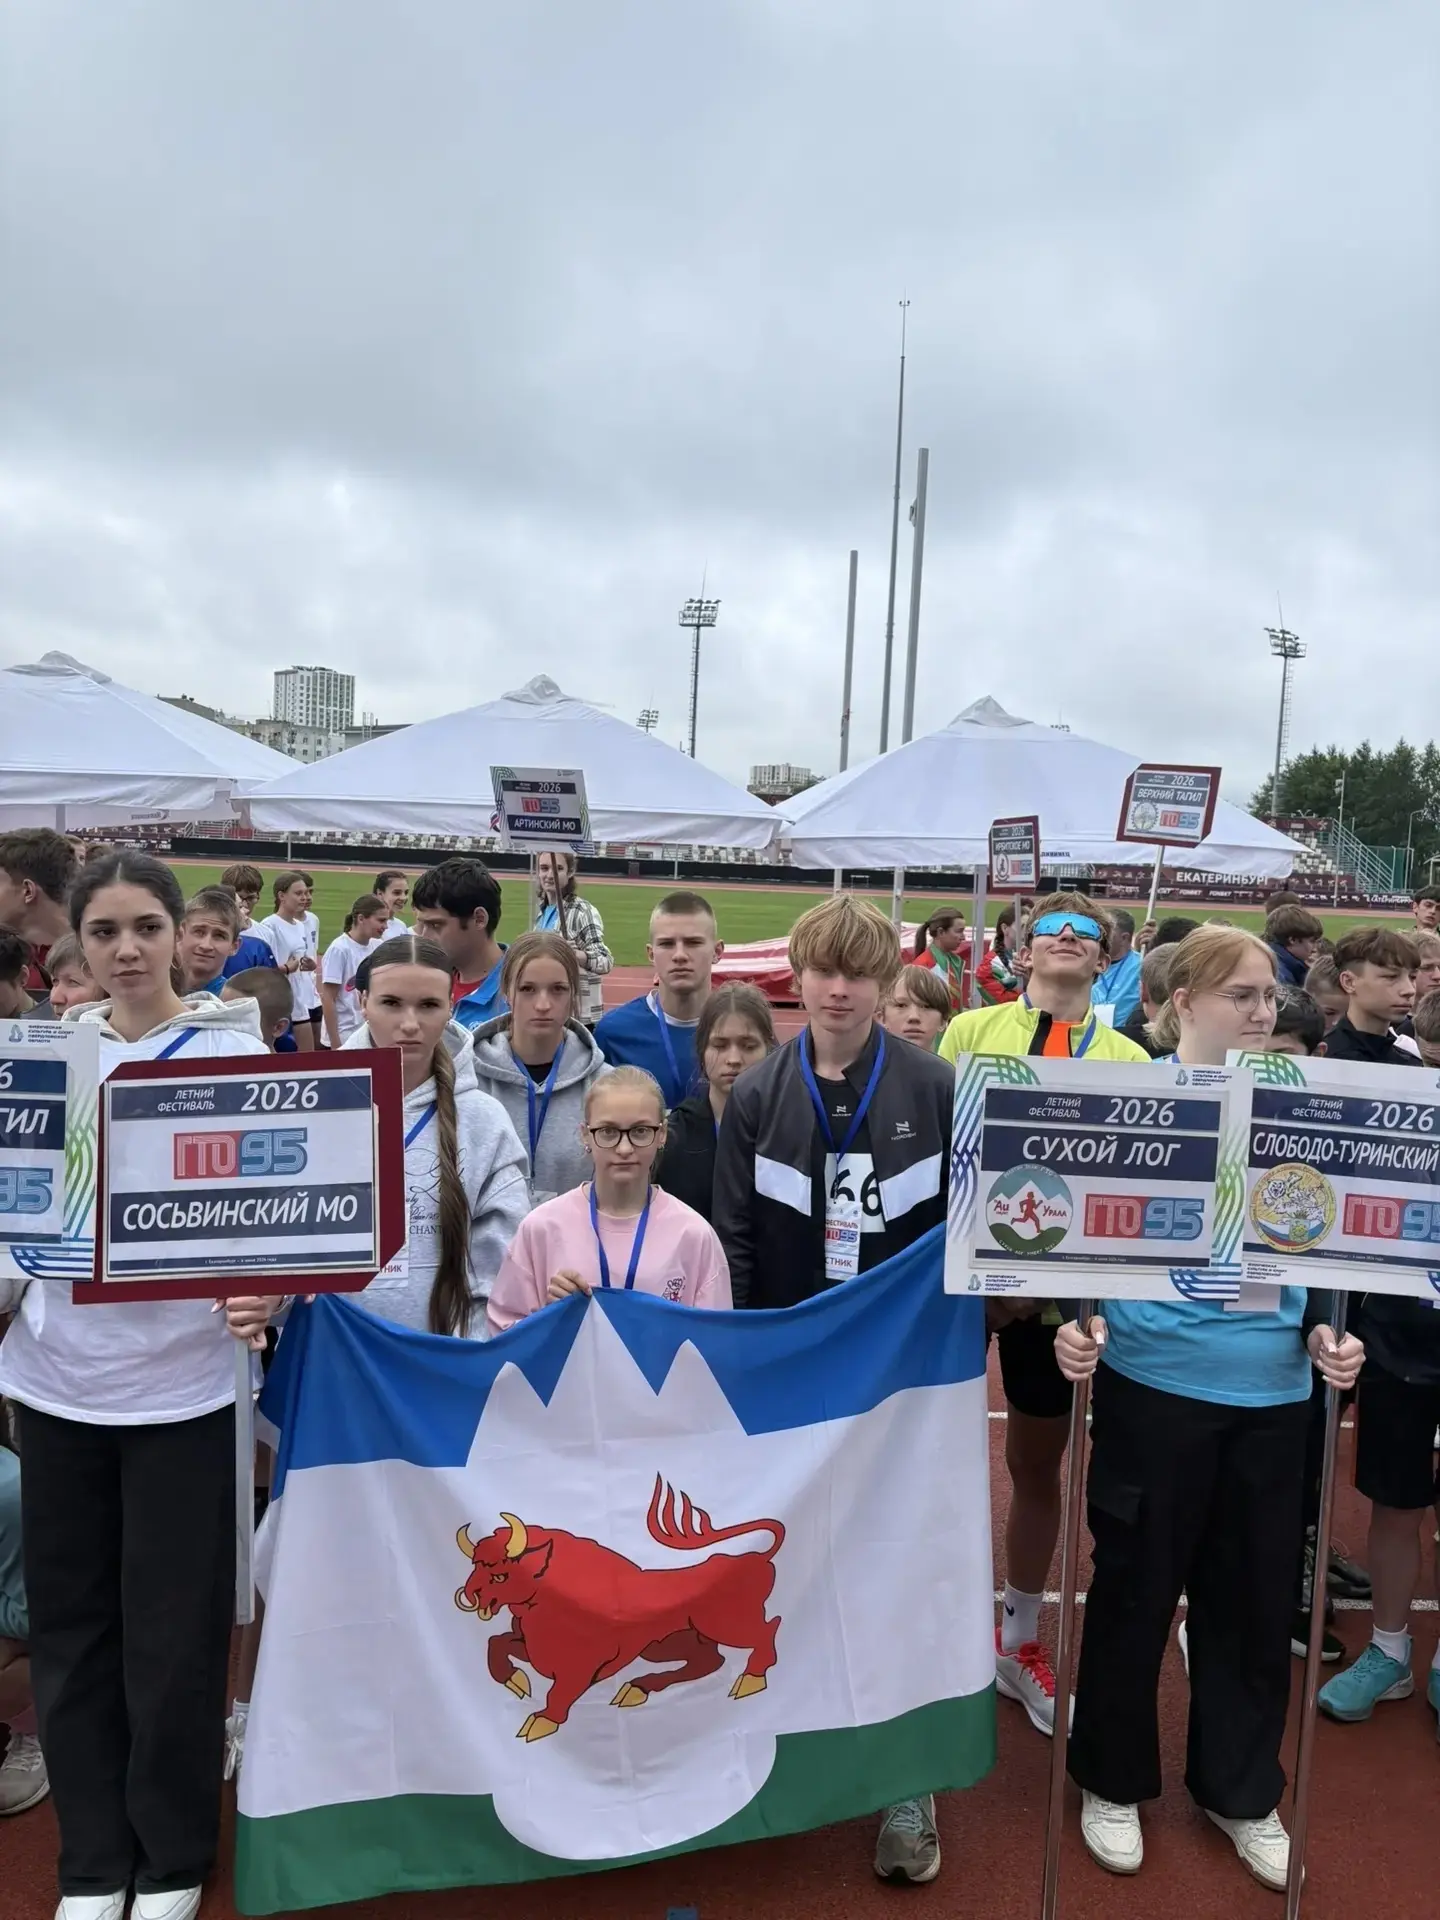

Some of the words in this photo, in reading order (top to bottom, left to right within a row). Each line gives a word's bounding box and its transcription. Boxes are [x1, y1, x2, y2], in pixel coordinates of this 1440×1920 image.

[1171, 775, 1195, 786] 2026
[538, 783, 561, 792] 2026
[1138, 788, 1174, 800] ВЕРХНИЙ
[1176, 791, 1202, 802] ТАГИЛ
[514, 819, 560, 830] АРТИНСКИЙ
[562, 822, 576, 830] МО
[175, 1087, 215, 1100] ЛЕТНИЙ
[241, 1080, 319, 1112] 2026
[157, 1101, 215, 1112] ФЕСТИВАЛЬ
[1045, 1096, 1082, 1108] ЛЕТНИЙ
[1308, 1098, 1343, 1110] ЛЕТНИЙ
[1028, 1107, 1081, 1119] ФЕСТИВАЛЬ
[1104, 1097, 1176, 1126] 2026
[1292, 1108, 1342, 1120] ФЕСТИВАЛЬ
[1365, 1102, 1435, 1132] 2026
[1022, 1134, 1118, 1164] СУХОЙ
[1124, 1141, 1181, 1167] ЛОГ
[1253, 1131, 1440, 1171] СЛОБОДО-ТУРИНСКИЙ
[123, 1191, 310, 1230] СОСЬВИНСКИЙ
[316, 1195, 357, 1222] МО
